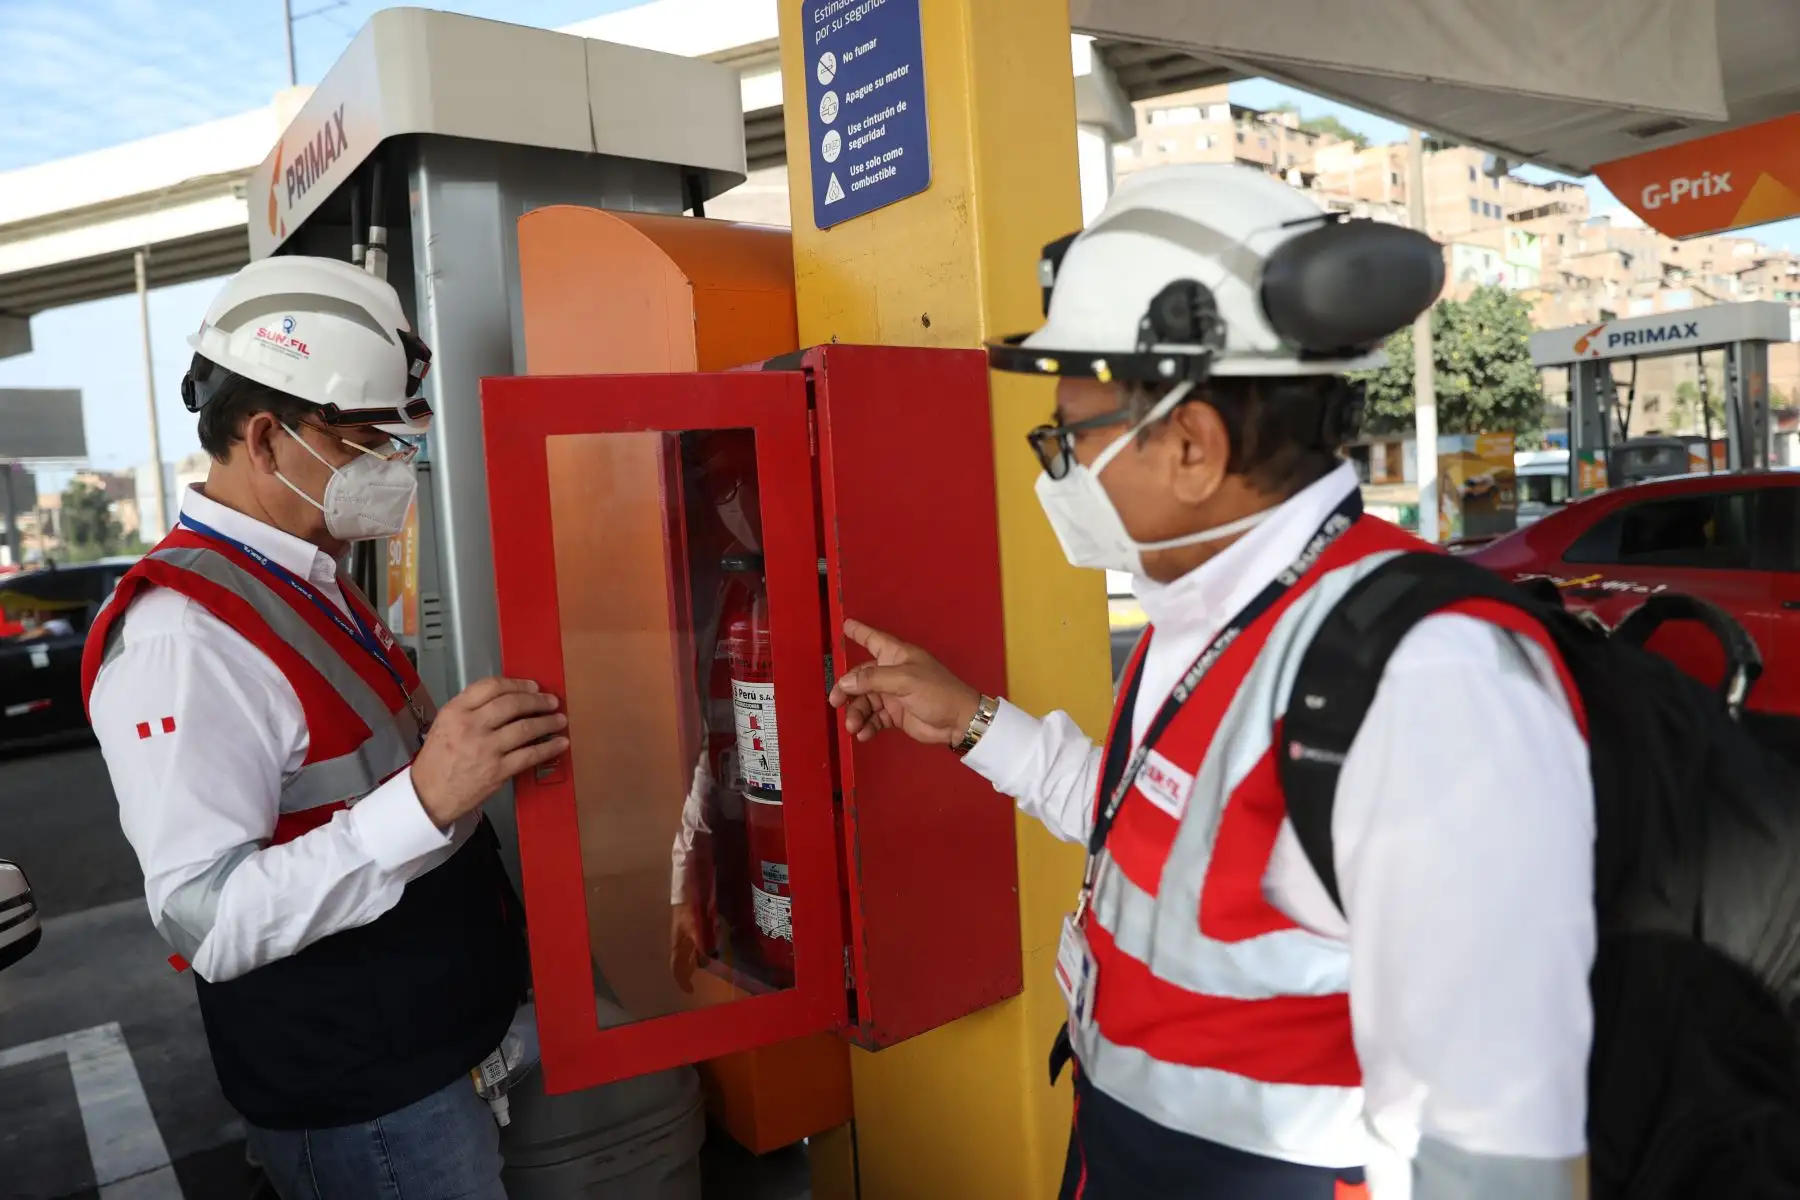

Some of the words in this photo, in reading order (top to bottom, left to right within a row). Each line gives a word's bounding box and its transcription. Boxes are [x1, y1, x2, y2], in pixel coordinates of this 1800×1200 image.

[814, 0, 855, 24] Estima
[815, 24, 830, 45] por
[832, 17, 843, 33] su
[843, 52, 854, 65] No
[855, 38, 877, 58] fumar
[845, 84, 873, 105] Apague
[874, 77, 885, 90] su
[885, 64, 910, 83] motor
[847, 121, 862, 136] Use
[863, 106, 895, 128] cinturón
[896, 100, 907, 113] de
[848, 125, 886, 151] seguridad
[286, 102, 348, 210] PRIMAX
[850, 163, 865, 177] Use
[865, 155, 882, 171] solo
[882, 146, 904, 163] como
[851, 165, 897, 192] combustible
[1641, 170, 1733, 210] G-Prix
[1608, 322, 1698, 348] PRIMAX
[738, 689, 757, 700] Perú
[759, 693, 776, 701] S.A.
